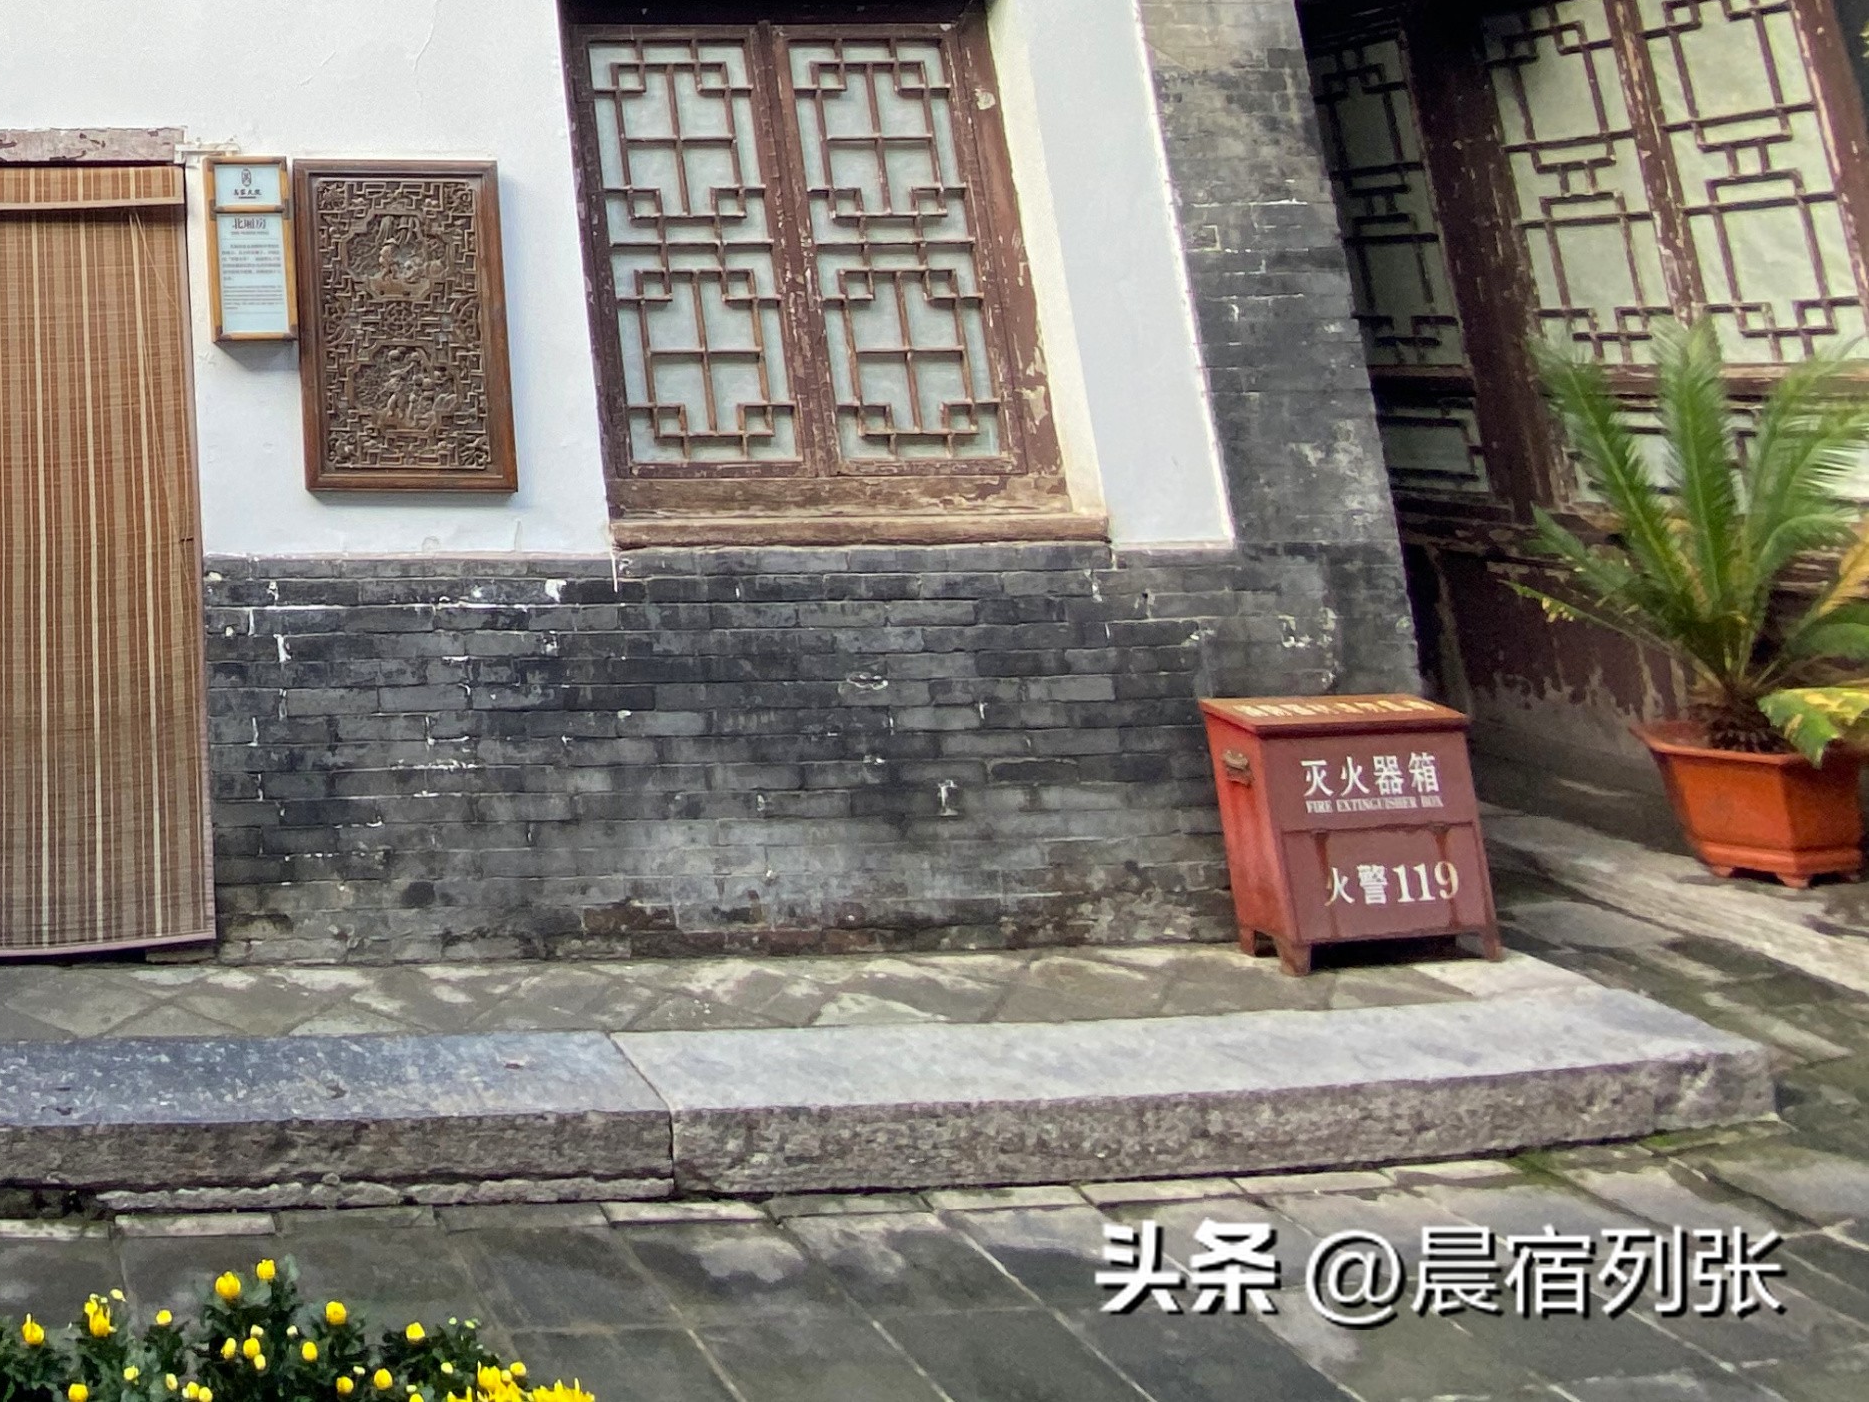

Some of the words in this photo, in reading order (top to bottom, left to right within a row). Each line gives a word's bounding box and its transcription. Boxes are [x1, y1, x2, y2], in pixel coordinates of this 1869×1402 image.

[1301, 752, 1440, 797] 灭火器箱
[1305, 800, 1333, 814] FIRE
[1336, 796, 1418, 812] EXTINGUISHER
[1421, 795, 1444, 808] BOX
[1323, 860, 1460, 907] 火警119
